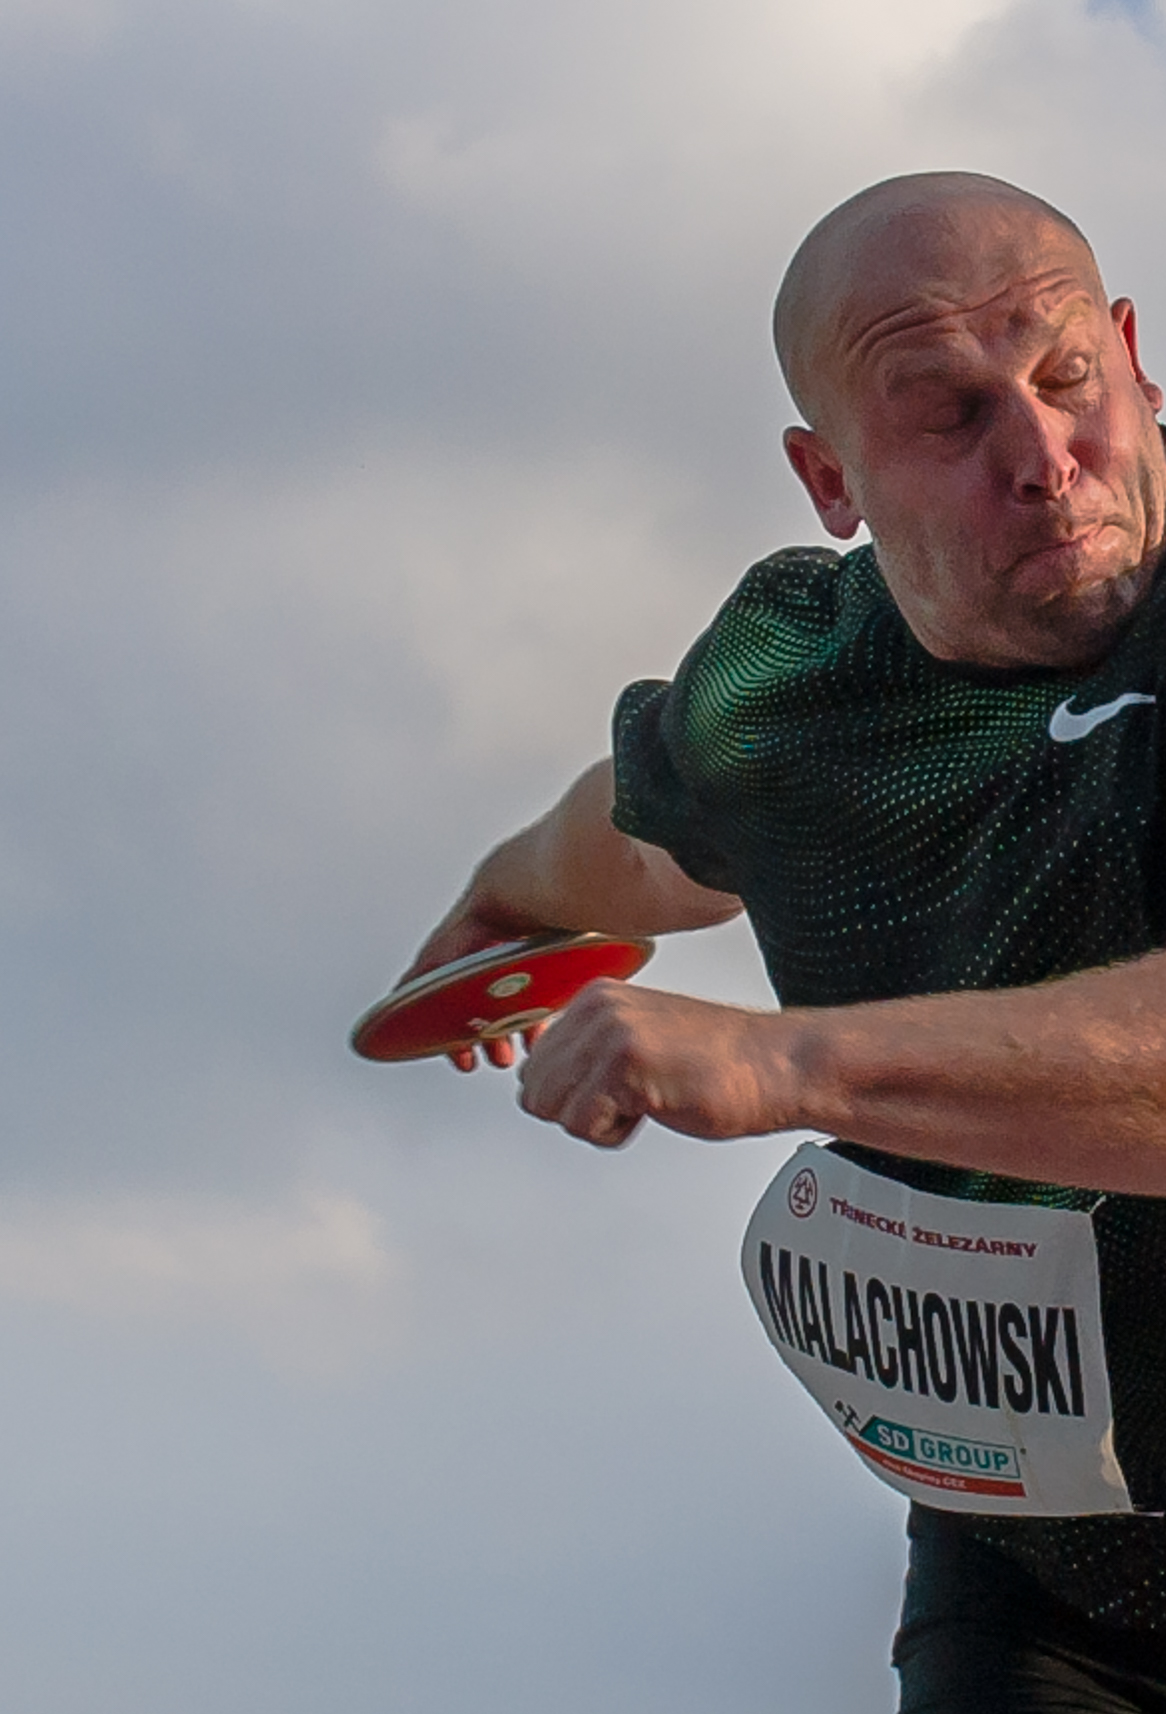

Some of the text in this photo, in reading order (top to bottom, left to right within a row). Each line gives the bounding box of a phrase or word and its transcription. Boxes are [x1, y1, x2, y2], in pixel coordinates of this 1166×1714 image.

[912, 1226, 1038, 1258] ŽELEZÁRNY
[760, 1241, 1085, 1417] MALACHOWSKI
[876, 1423, 909, 1452] SD
[919, 1438, 1010, 1473] GROUP
